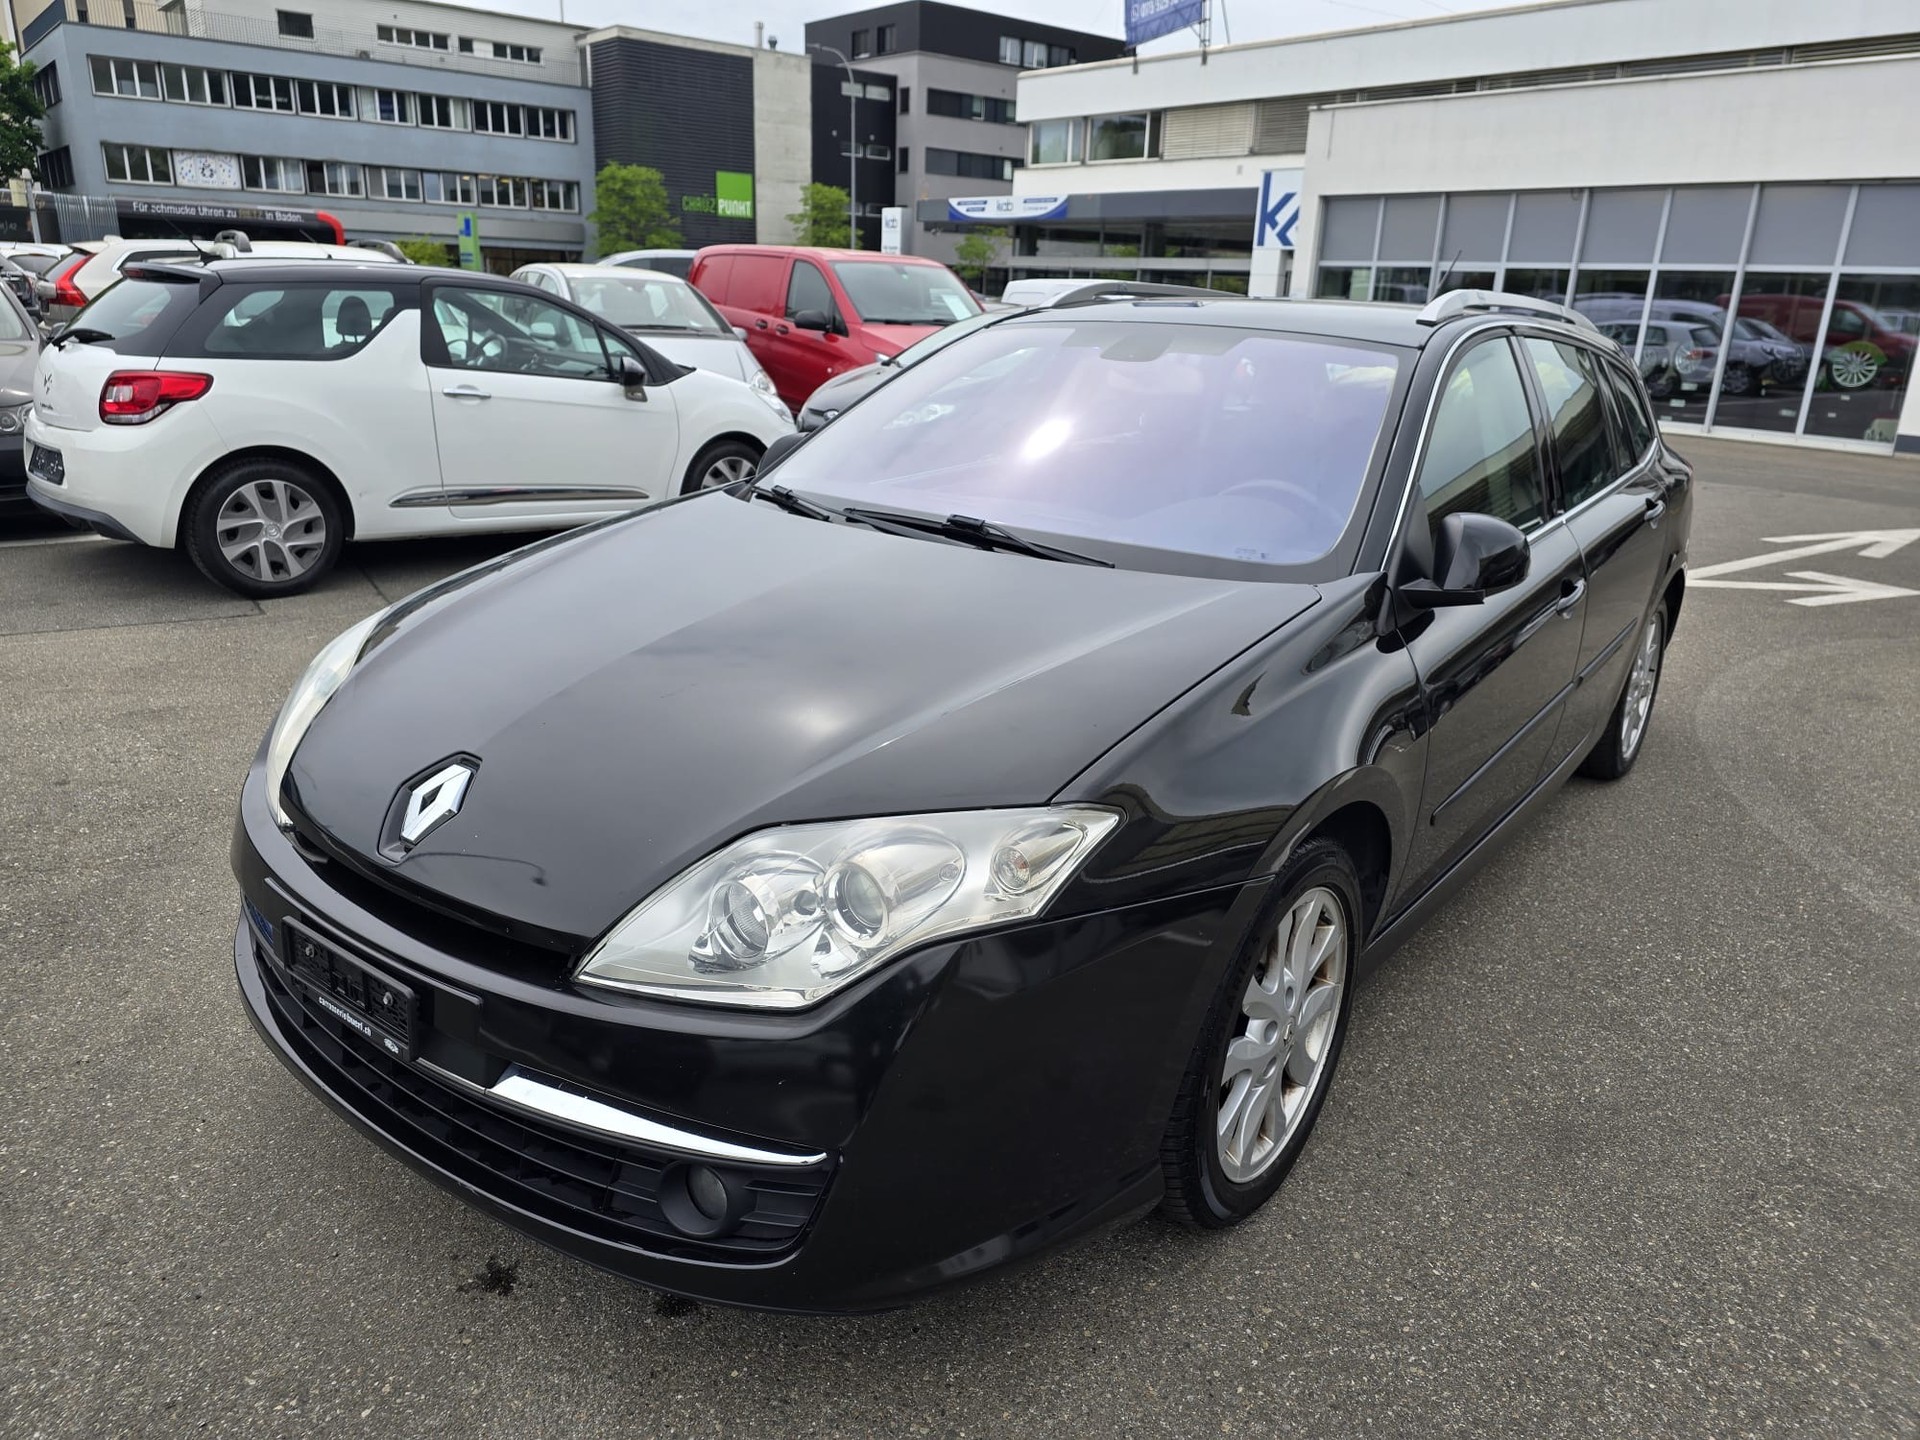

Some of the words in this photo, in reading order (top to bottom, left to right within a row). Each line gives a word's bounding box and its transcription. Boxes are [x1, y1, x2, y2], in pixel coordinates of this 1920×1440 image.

[132, 201, 149, 212] Für
[151, 203, 196, 216] schmucke
[198, 206, 225, 217] Uhren
[226, 210, 238, 218] zu
[275, 211, 305, 223] Baden.
